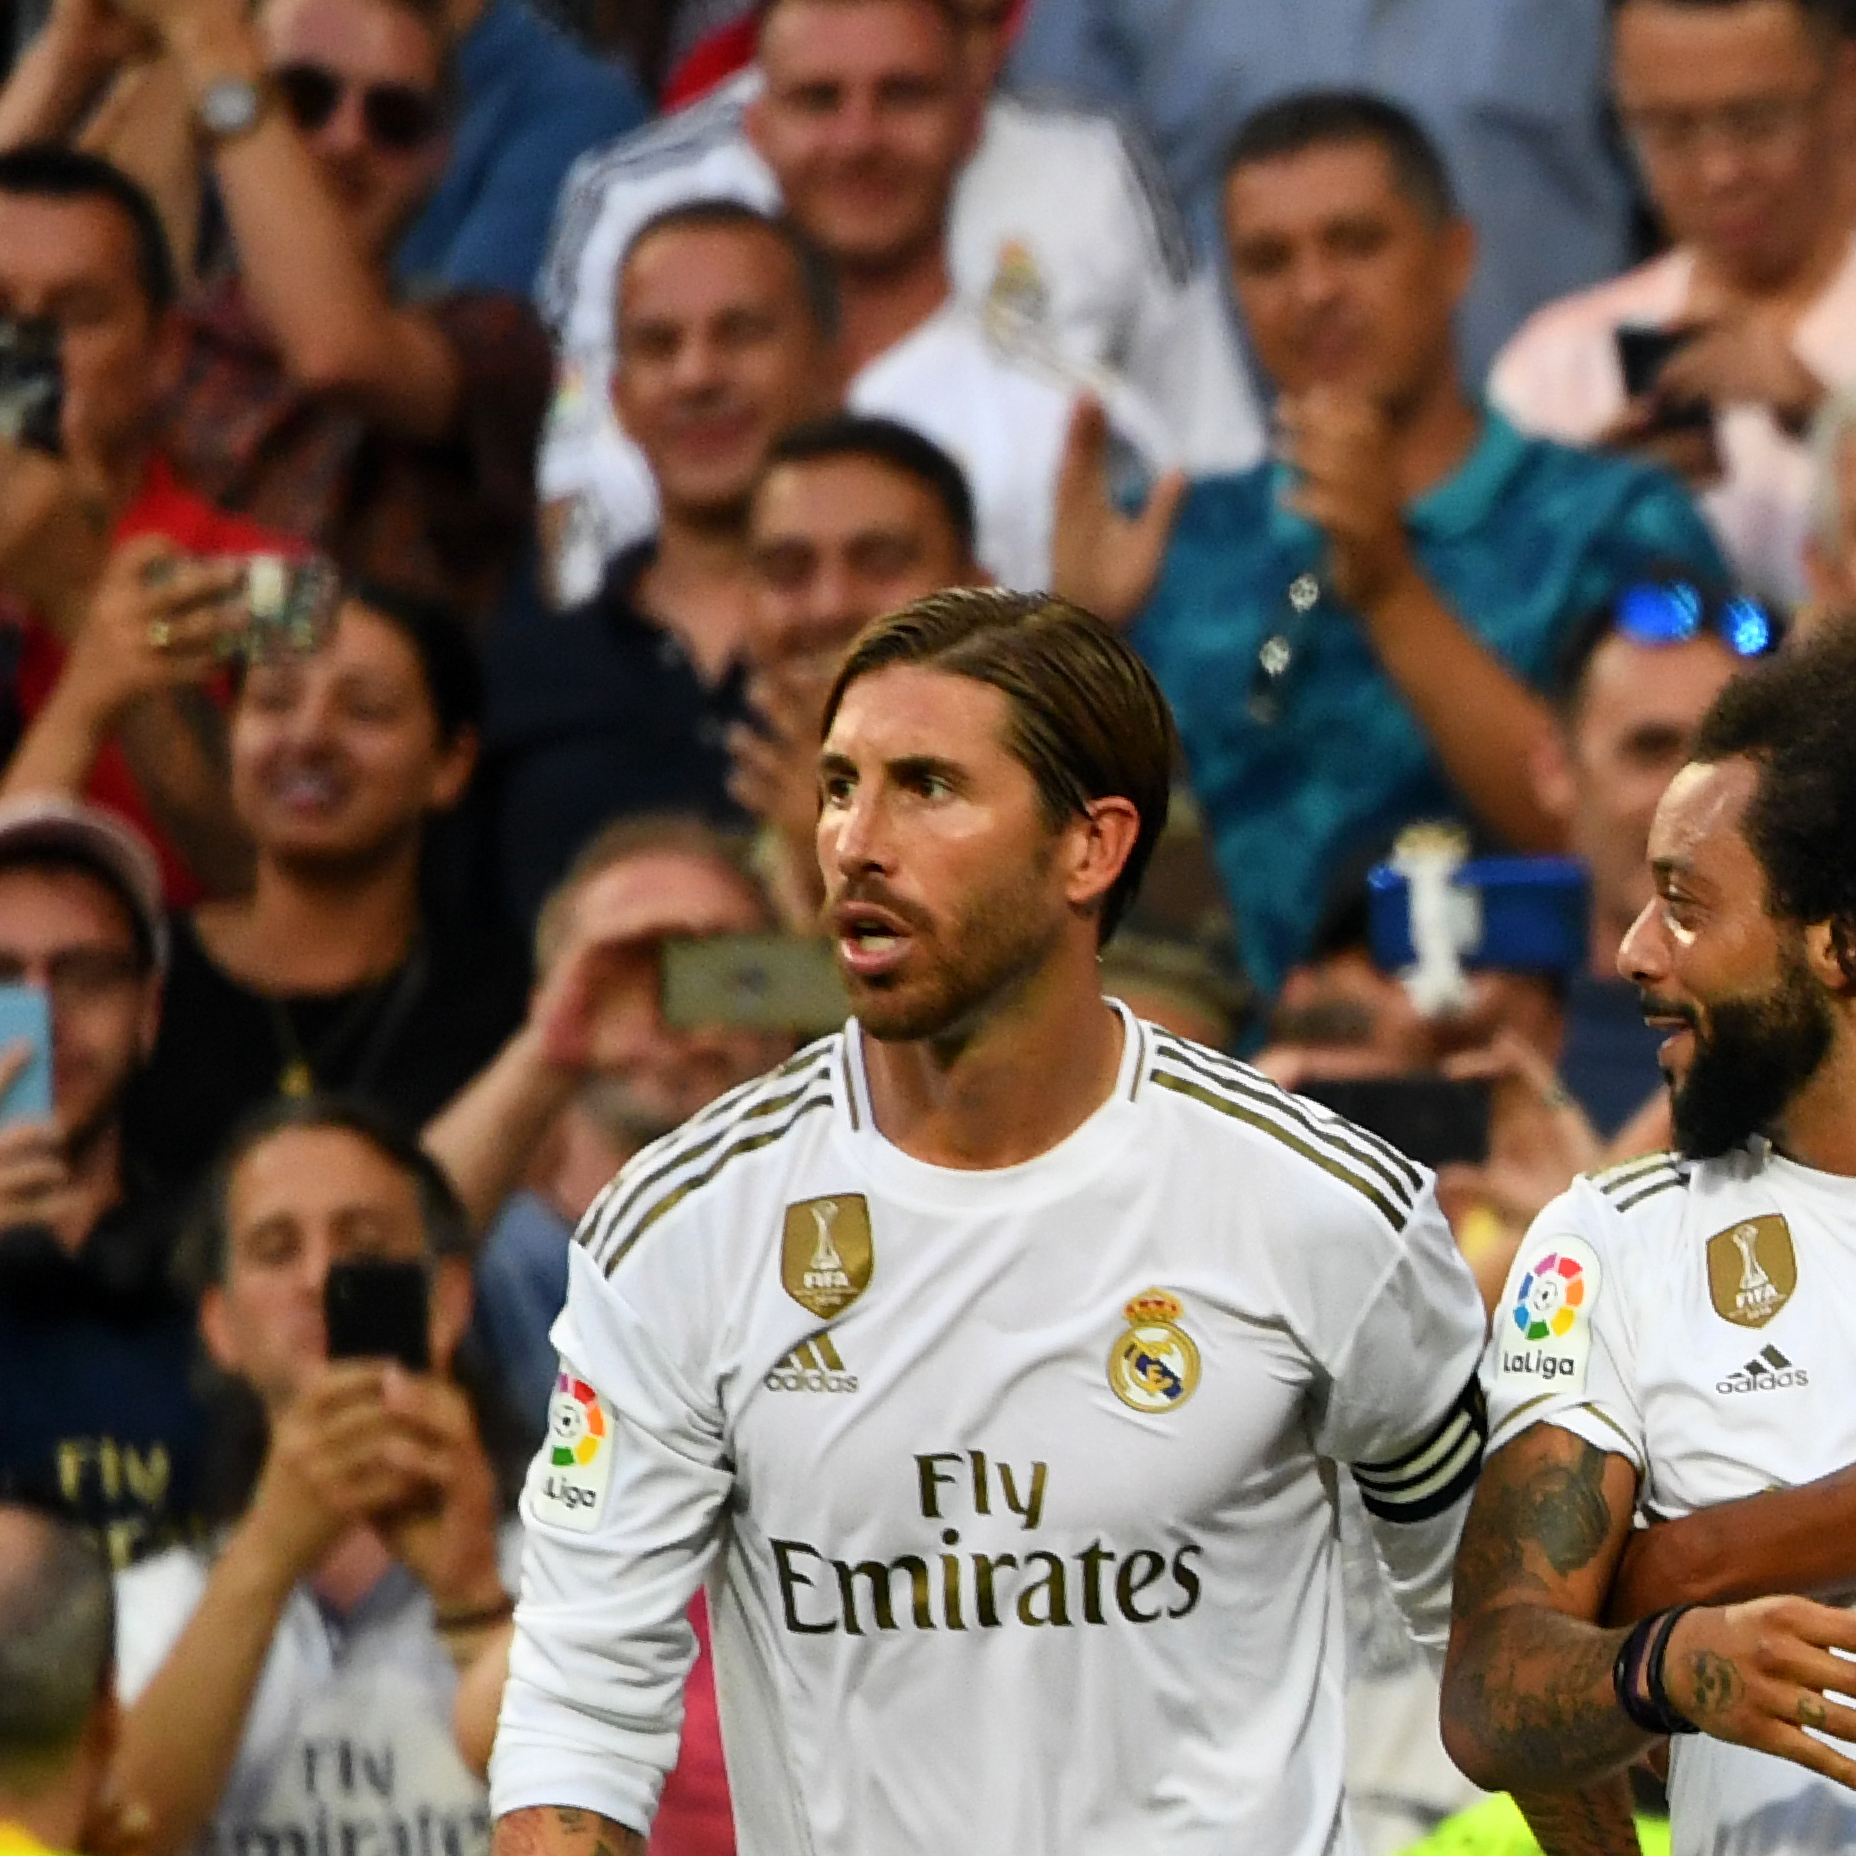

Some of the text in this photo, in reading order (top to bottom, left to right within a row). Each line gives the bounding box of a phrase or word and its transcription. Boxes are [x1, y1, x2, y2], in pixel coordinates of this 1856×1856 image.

[1736, 1283, 1778, 1308] FIFA
[1503, 1350, 1575, 1379] LaLiga
[764, 1368, 860, 1395] adidas
[1716, 1368, 1809, 1395] adidas
[543, 1475, 596, 1511] Liga
[914, 1449, 1047, 1531] Fly
[770, 1529, 1204, 1637] Emirates
